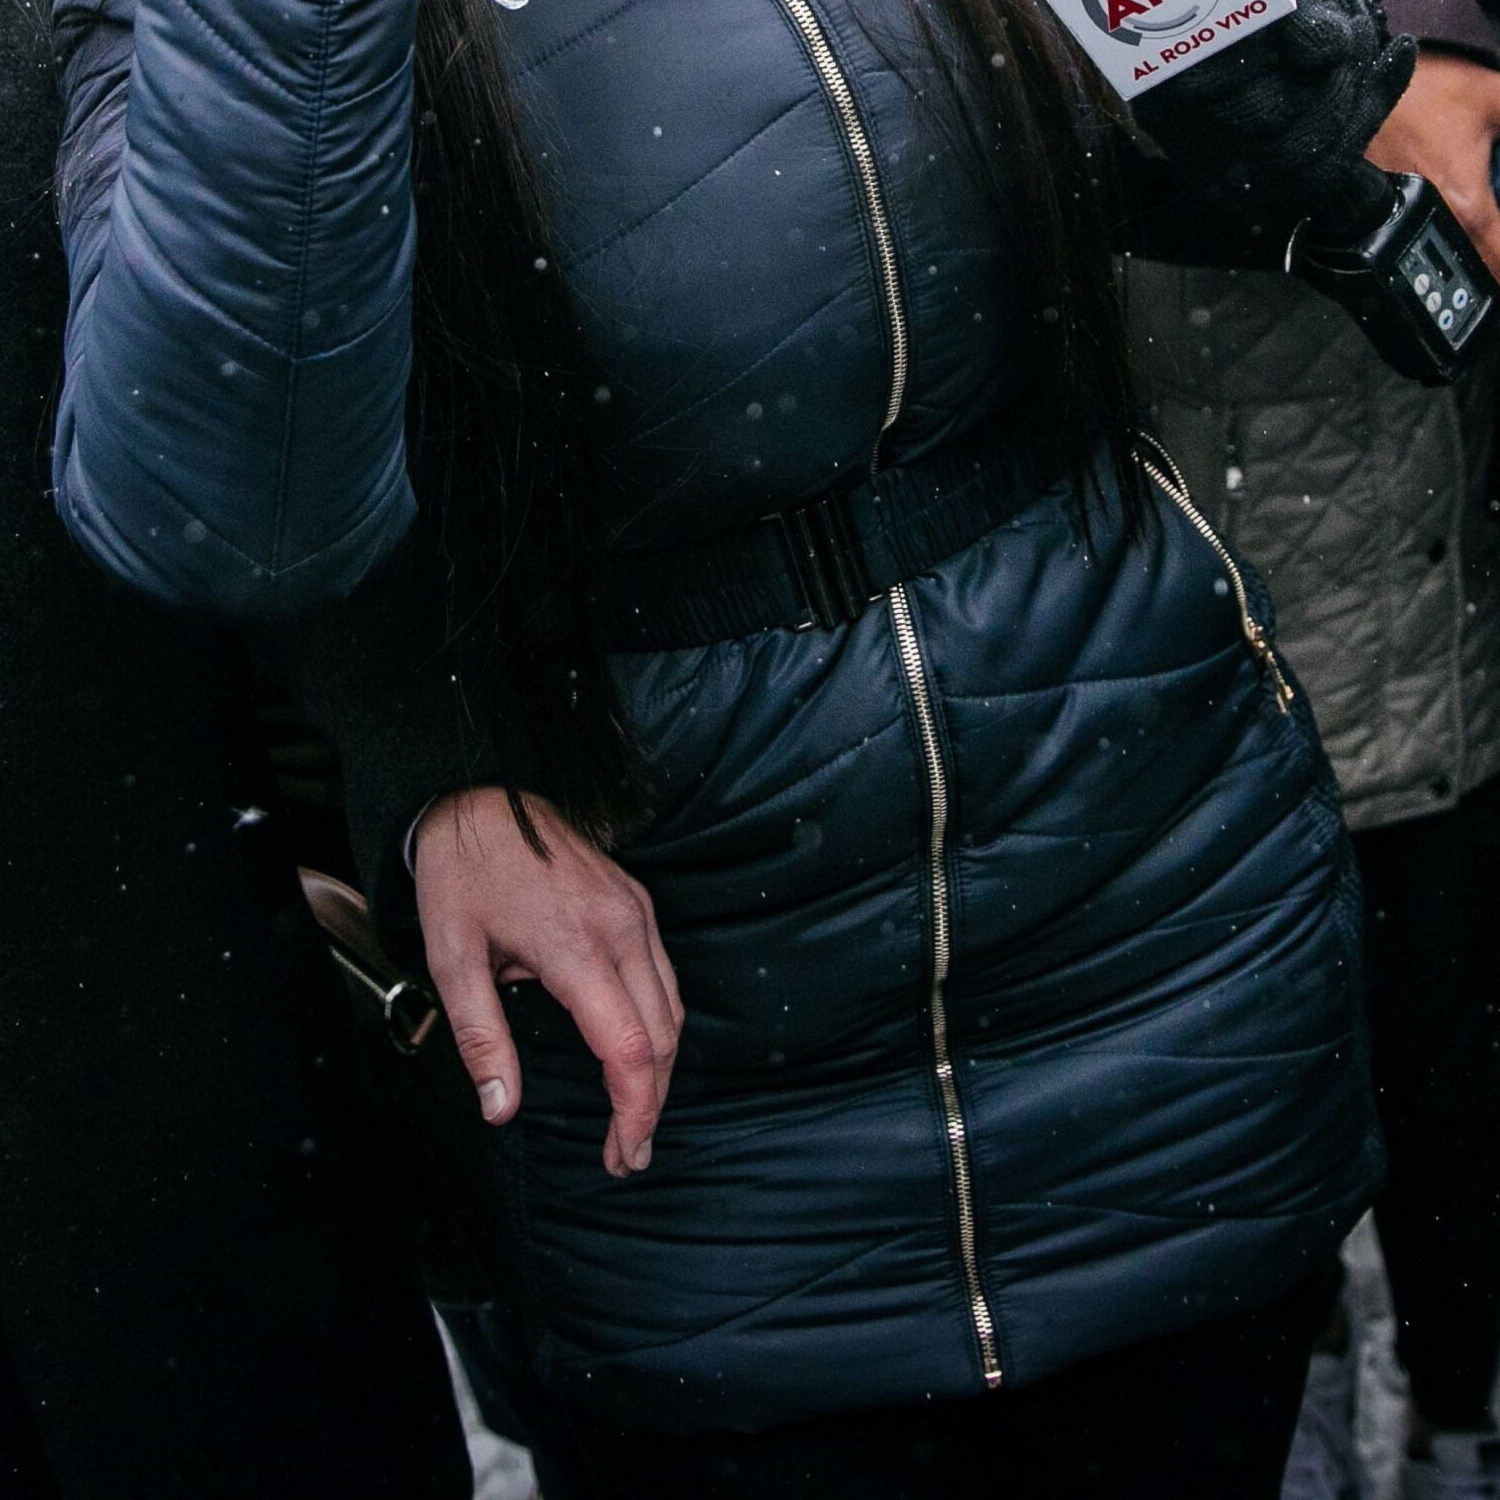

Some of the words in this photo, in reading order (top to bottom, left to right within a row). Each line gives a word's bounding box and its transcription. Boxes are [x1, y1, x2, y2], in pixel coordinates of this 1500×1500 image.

[1134, 61, 1159, 81] AL
[1160, 28, 1215, 64] ROJO
[1215, 0, 1268, 30] VIVO
